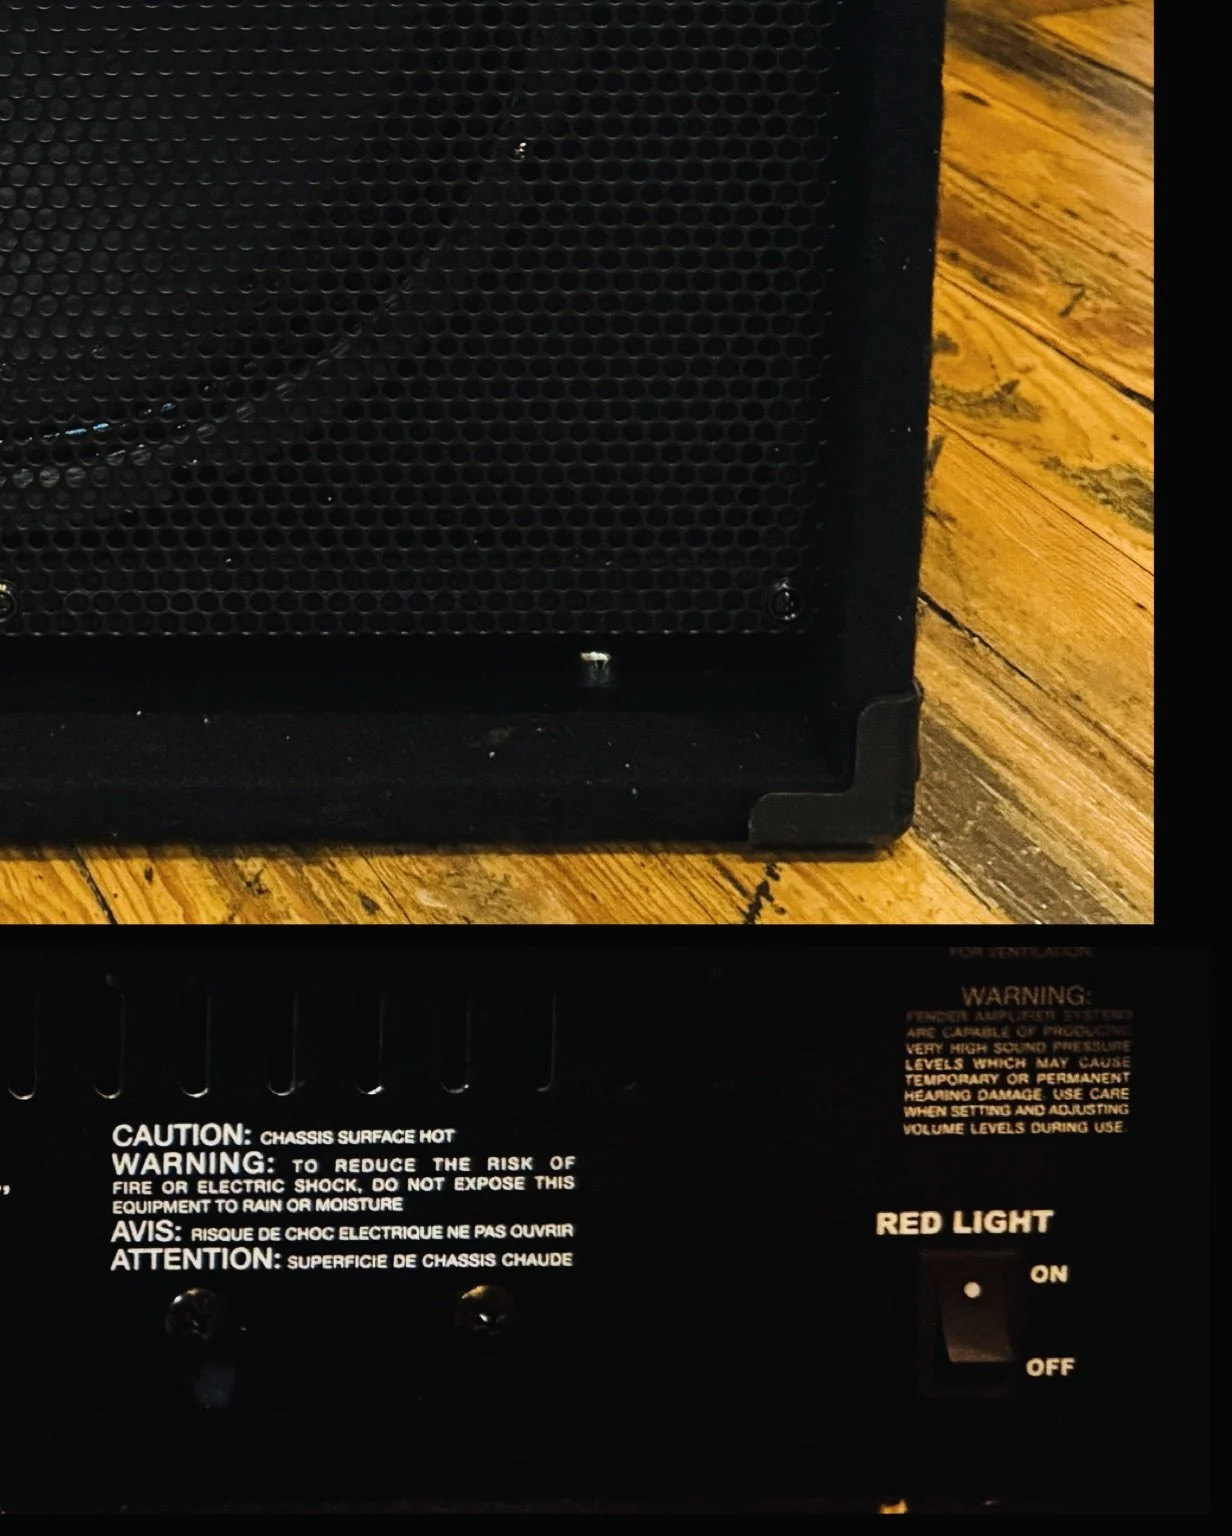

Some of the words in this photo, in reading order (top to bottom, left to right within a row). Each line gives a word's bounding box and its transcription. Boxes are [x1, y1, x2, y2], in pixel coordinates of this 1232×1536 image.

[961, 985, 1093, 1006] WARNING:
[906, 1027, 935, 1039] ARE
[905, 1043, 943, 1055] VERY
[949, 1042, 988, 1055] HIGH
[993, 1042, 1046, 1054] SOUND
[1052, 1040, 1131, 1053] PRESSURE
[905, 1058, 964, 1071] LEVELS
[972, 1057, 1027, 1070] WHICH
[1035, 1057, 1069, 1069] MAY
[1078, 1056, 1131, 1069] CAUSE
[905, 1074, 1001, 1087] TEMPORARY
[1007, 1073, 1029, 1085] OR
[1036, 1071, 1131, 1085] PERMANENT
[904, 1089, 972, 1103] HEARING
[1052, 1088, 1084, 1100] USE
[1089, 1087, 1130, 1100] CARE
[903, 1105, 947, 1118] WHEN
[950, 1104, 1012, 1117] SETTING
[1015, 1104, 1046, 1116] AND
[1048, 1103, 1129, 1116] ADJUSTING
[112, 1123, 251, 1147] CAUTION:
[260, 1130, 334, 1145] CHASSIS
[337, 1129, 415, 1145] SURFACE
[419, 1128, 456, 1143] HOT
[903, 1122, 965, 1136] VOLUME
[970, 1122, 1025, 1135] LEVELS
[1030, 1121, 1089, 1134] DURING
[112, 1152, 275, 1175] WARNING:
[292, 1158, 318, 1173] TO
[335, 1157, 416, 1173] REDUCE
[432, 1157, 471, 1172] THE
[487, 1156, 534, 1171] RISK
[550, 1156, 575, 1170] OF
[113, 1180, 152, 1195] FIRE
[161, 1180, 188, 1195] OR
[197, 1179, 285, 1194] ELECTRIC
[372, 1178, 398, 1192] DO
[407, 1177, 445, 1192] NOT
[454, 1176, 525, 1191] EXPOSE
[536, 1176, 575, 1190] THIS
[112, 1199, 212, 1215] EQUIPMENT
[214, 1199, 238, 1214] TO
[243, 1198, 283, 1213] RAIN
[286, 1198, 312, 1213] OR
[315, 1197, 404, 1212] MOISTURE
[111, 1220, 182, 1242] AVIS:
[191, 1227, 254, 1243] RISQUE
[258, 1227, 281, 1242] DE
[284, 1226, 335, 1241] CHOC
[338, 1225, 444, 1242] ELECTRIQUE
[447, 1224, 470, 1239] NE
[473, 1224, 507, 1239] PAS
[510, 1223, 574, 1238] OUVRIR
[876, 1211, 942, 1235] RED
[953, 1209, 1055, 1234] LIGHT
[111, 1247, 281, 1271] ATTENTION:
[287, 1254, 387, 1270] SUPERFICIE
[393, 1254, 417, 1268] DE
[422, 1253, 496, 1268] CHASSIS
[501, 1252, 573, 1268] CHAUDE
[1030, 1264, 1068, 1284] ON
[1026, 1357, 1075, 1377] OFF
